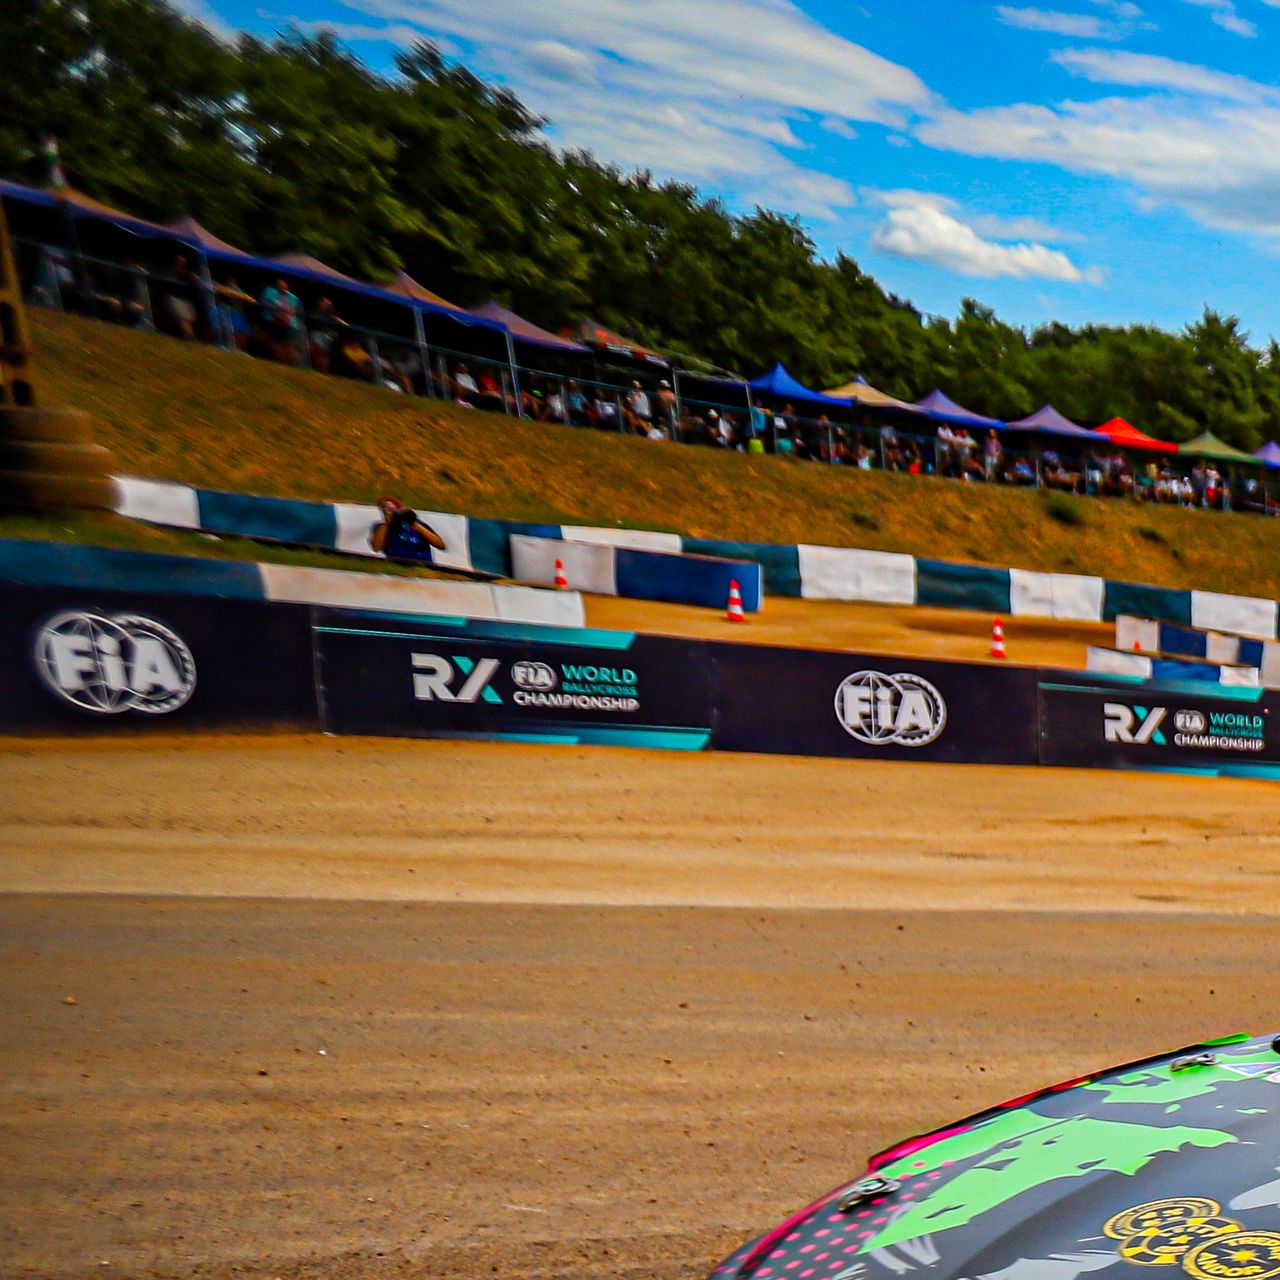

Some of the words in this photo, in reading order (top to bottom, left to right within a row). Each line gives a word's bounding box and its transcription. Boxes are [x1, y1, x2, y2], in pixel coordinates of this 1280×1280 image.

[46, 633, 185, 694] FIA
[411, 652, 504, 704] RX
[512, 664, 555, 687] FIA
[561, 664, 638, 685] WORLD
[562, 681, 638, 697] RALLYCROSS
[512, 691, 641, 712] CHAMPIONSHIP
[843, 685, 933, 730] FIA
[1103, 702, 1168, 745] RX
[1175, 711, 1204, 730] FIA
[1209, 711, 1263, 728] WORLD
[1173, 733, 1265, 751] CHAMPIONSHIP
